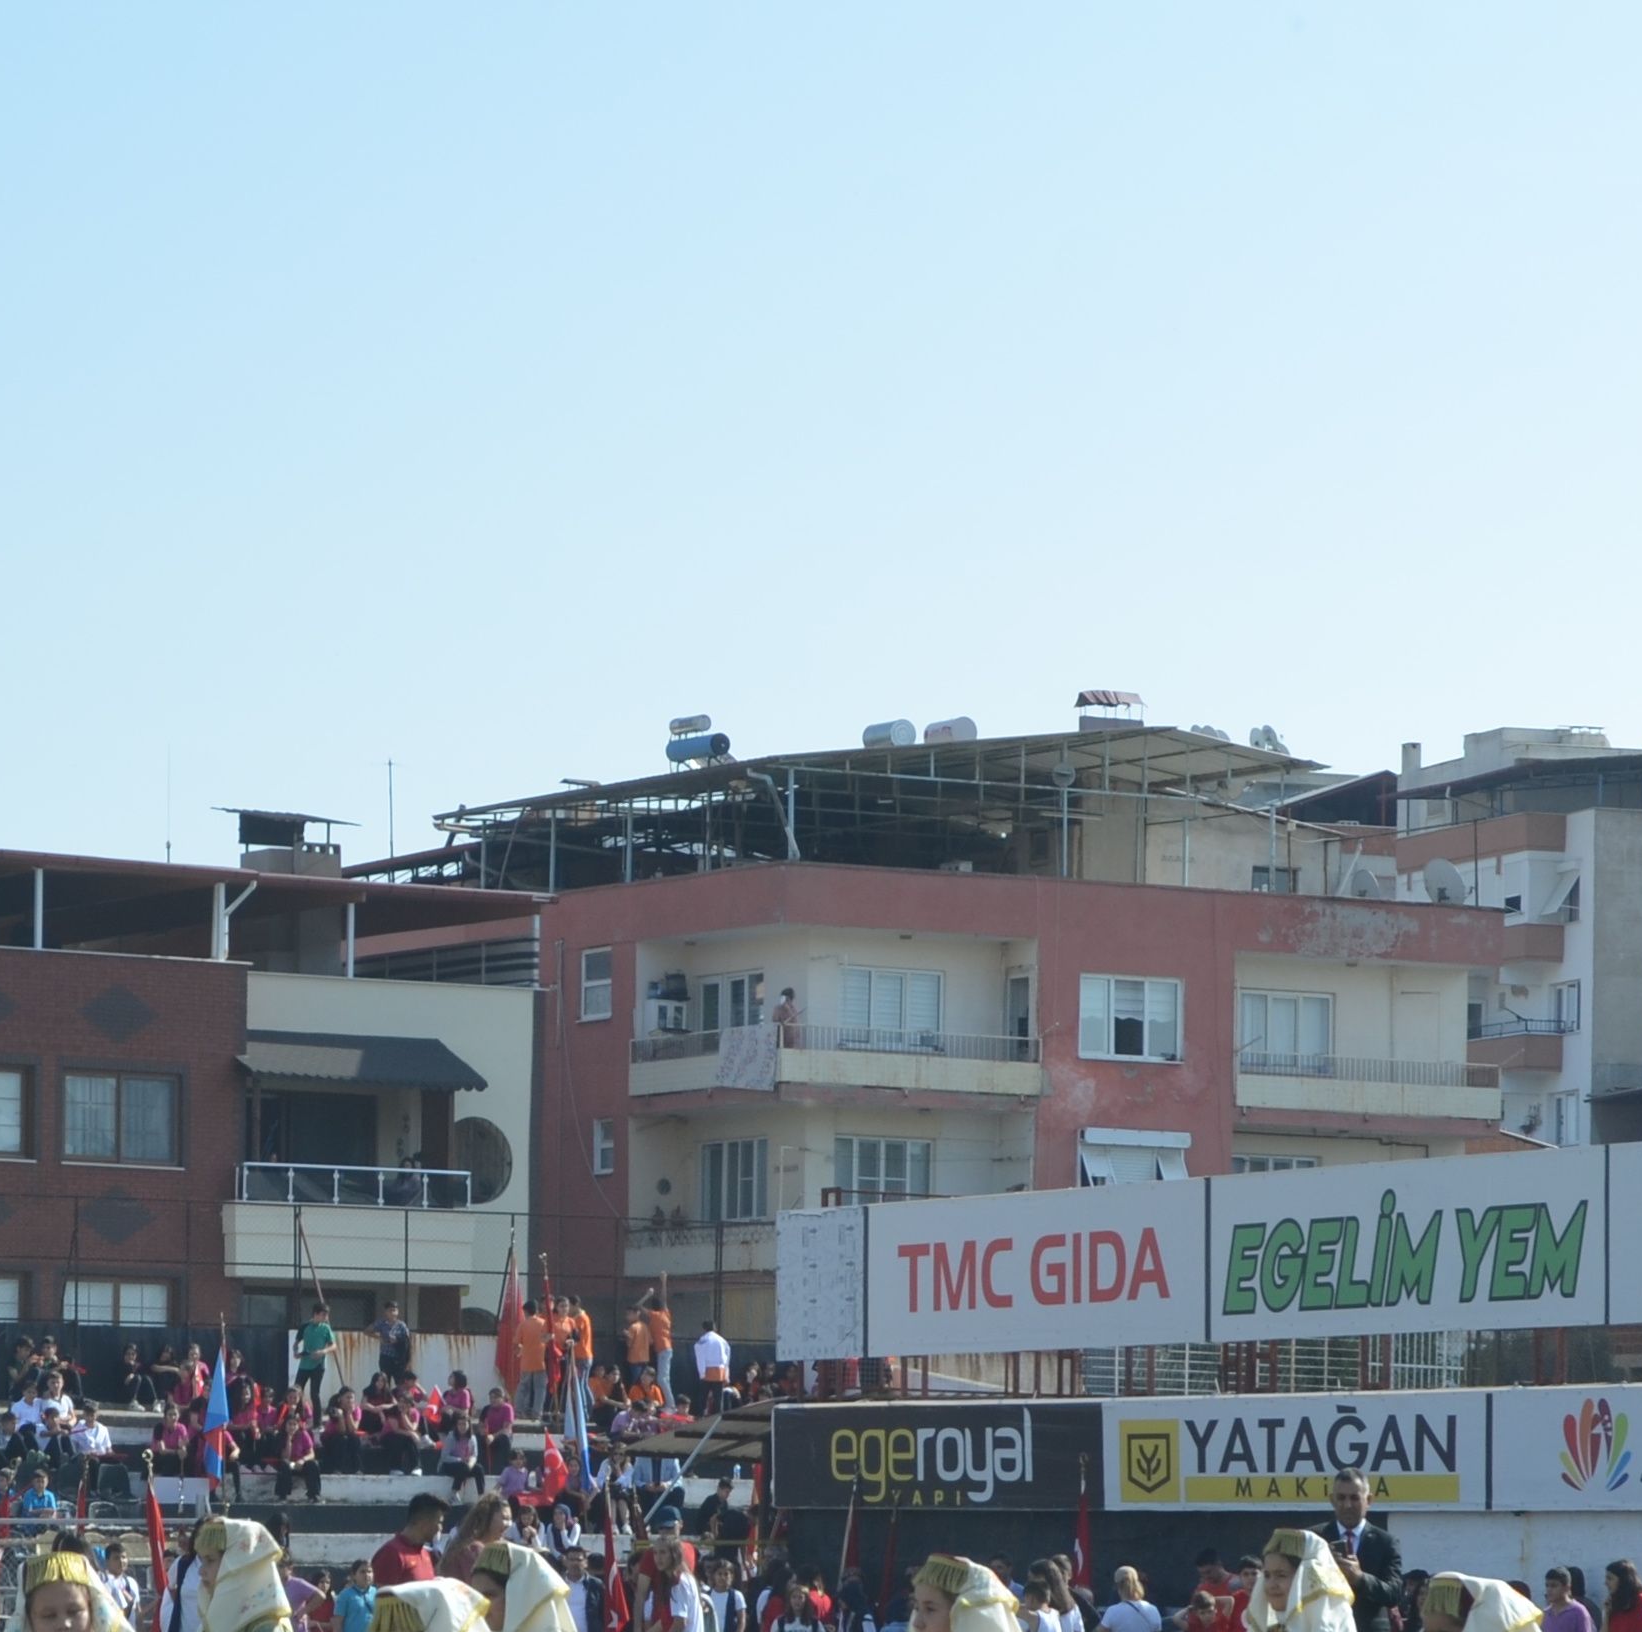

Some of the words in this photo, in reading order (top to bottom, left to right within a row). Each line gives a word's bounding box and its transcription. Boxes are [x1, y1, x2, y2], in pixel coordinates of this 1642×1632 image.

[898, 1237, 1013, 1313] TMC
[1030, 1227, 1171, 1306] GIDA
[1222, 1189, 1443, 1316] EGELİM
[1455, 1200, 1588, 1303] YEM
[831, 1406, 1033, 1502] egeroyal
[1184, 1405, 1457, 1474] YATAĞAN
[1235, 1476, 1390, 1499] MAKiA
